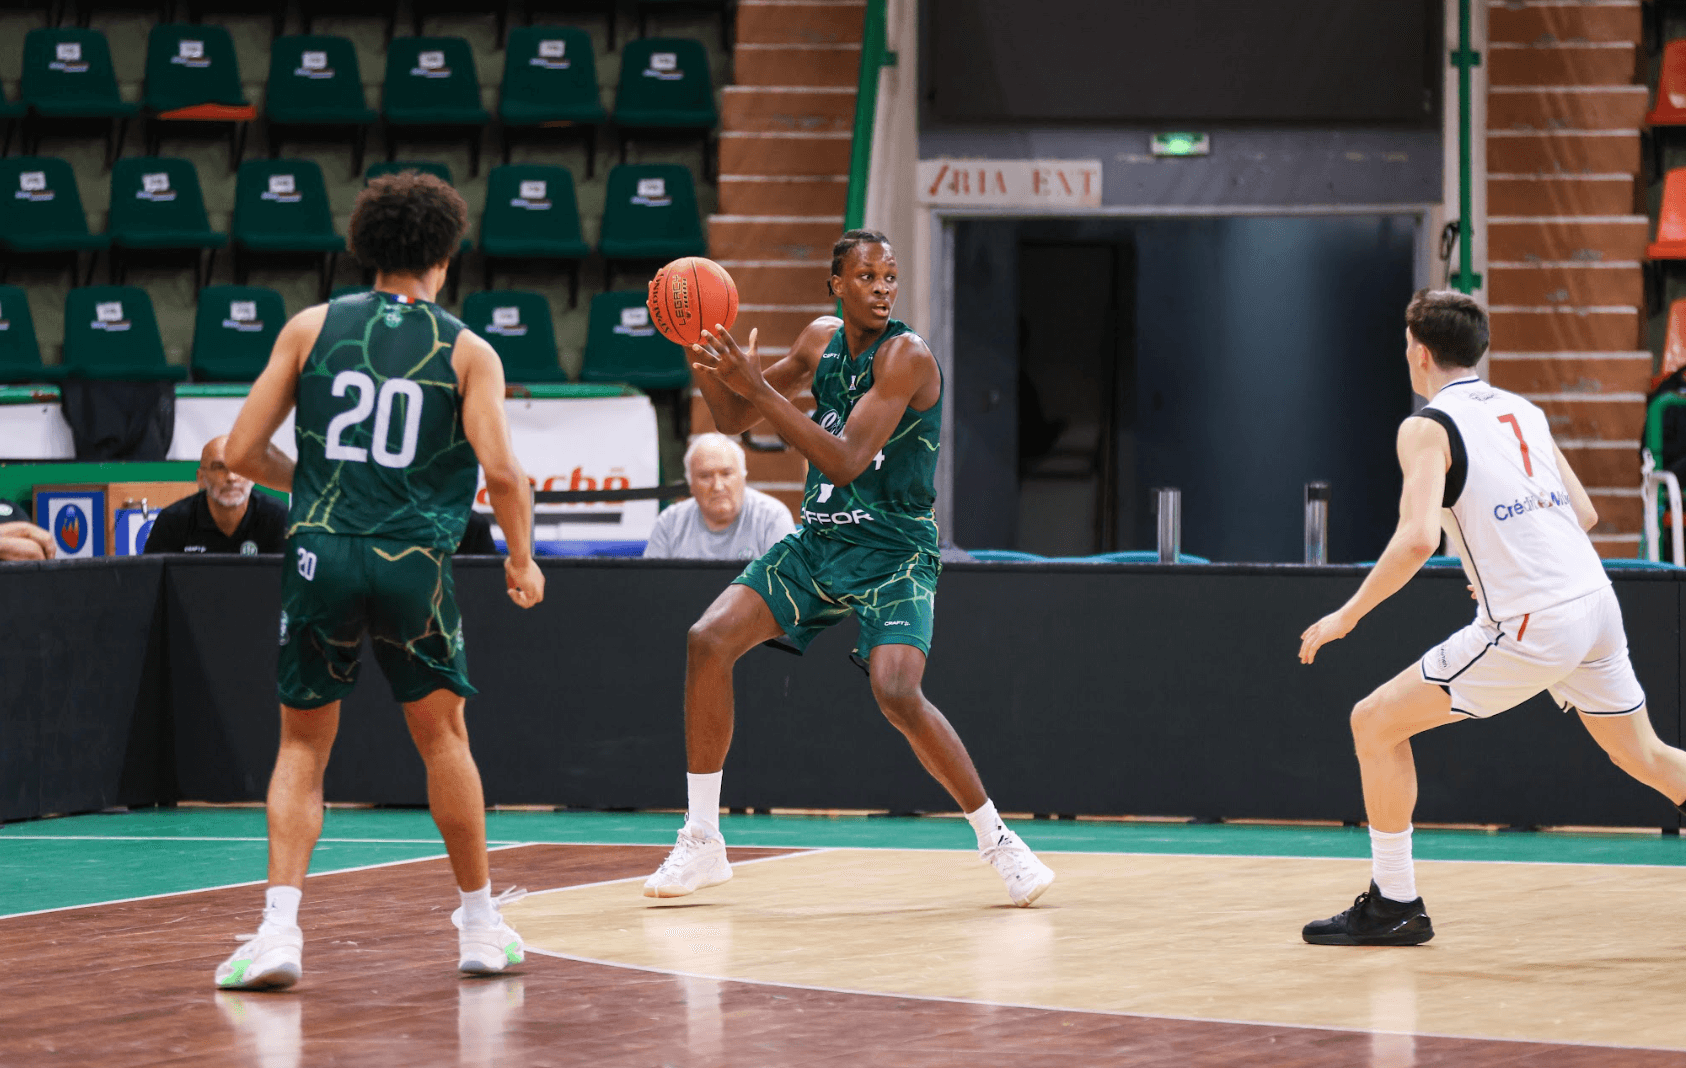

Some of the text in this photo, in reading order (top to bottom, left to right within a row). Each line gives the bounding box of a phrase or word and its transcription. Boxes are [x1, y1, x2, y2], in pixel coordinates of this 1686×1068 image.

[672, 274, 686, 326] LEGACY
[325, 370, 423, 468] 20
[1497, 413, 1533, 477] 7
[297, 547, 317, 581] 20
